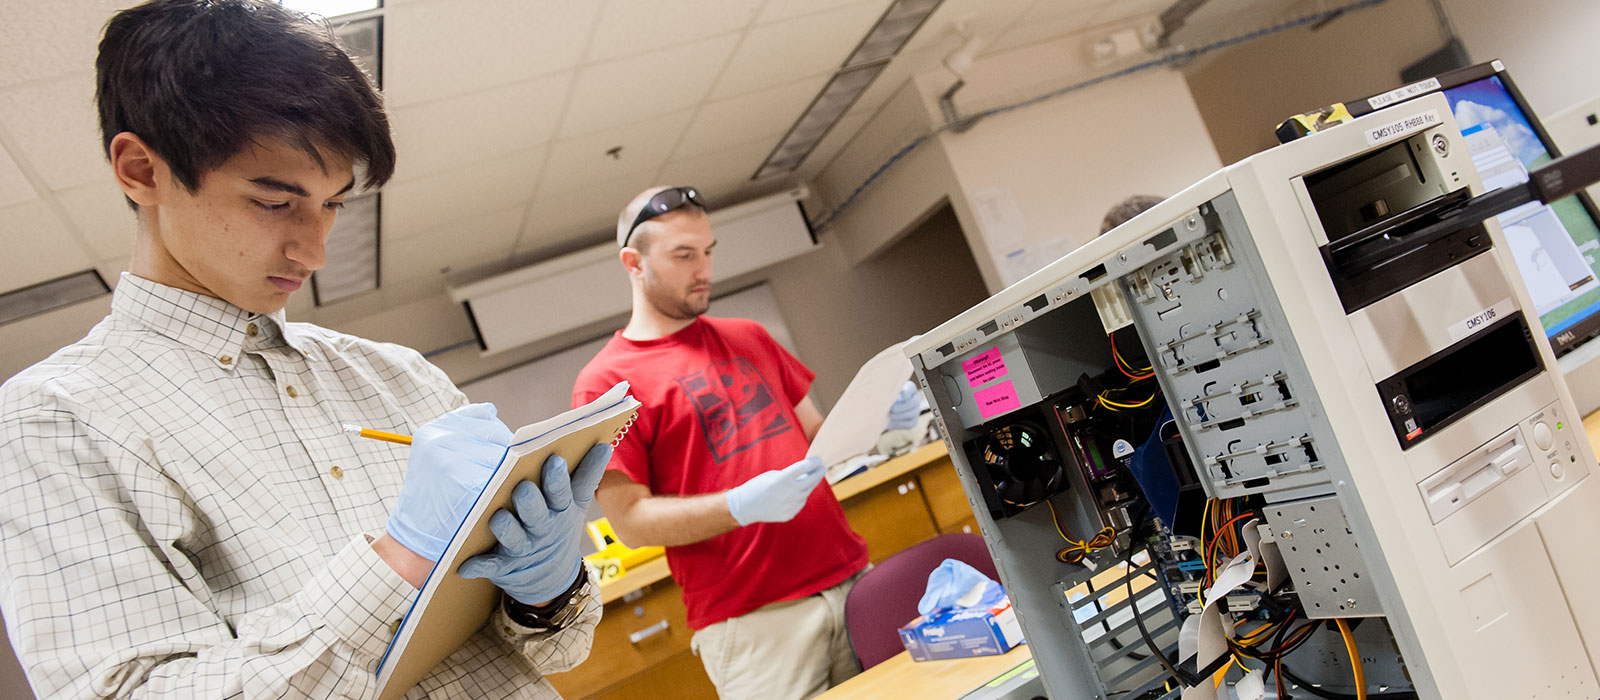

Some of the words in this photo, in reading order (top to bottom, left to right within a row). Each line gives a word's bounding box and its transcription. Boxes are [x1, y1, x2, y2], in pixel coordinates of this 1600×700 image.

[1407, 86, 1419, 95] NOT
[1420, 81, 1436, 90] TOUCH
[1372, 122, 1404, 141] CMSY105
[1466, 308, 1496, 329] CMSY106
